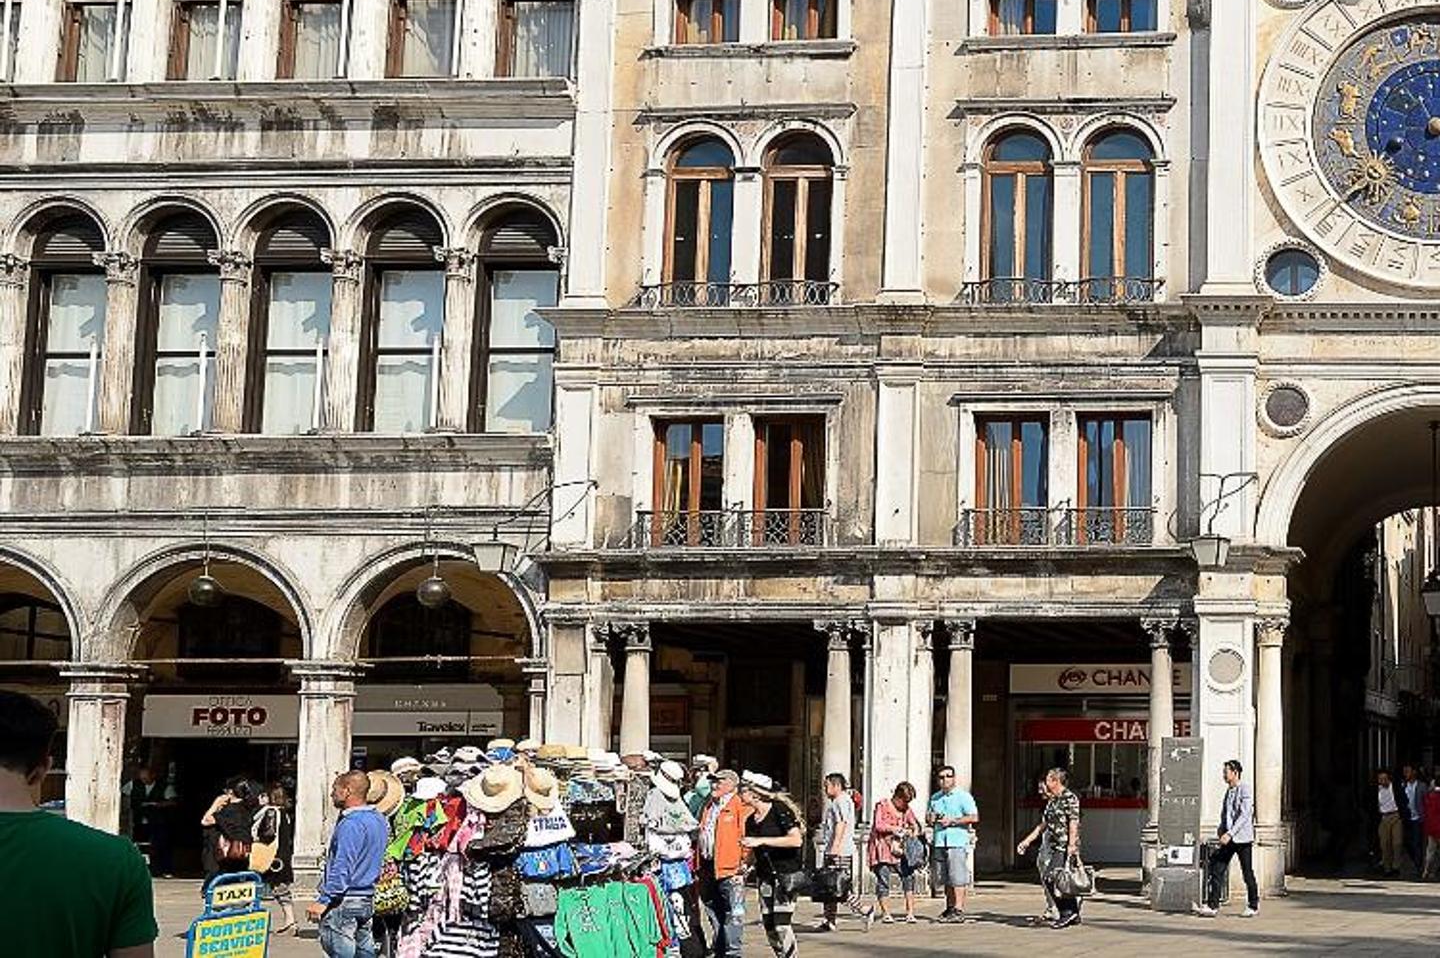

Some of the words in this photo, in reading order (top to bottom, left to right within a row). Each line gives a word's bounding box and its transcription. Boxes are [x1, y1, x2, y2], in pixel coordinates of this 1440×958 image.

[1091, 669, 1181, 686] CHANE
[192, 707, 267, 726] FOTO
[416, 721, 465, 732] Travelex
[1094, 721, 1192, 740] CHAE
[216, 888, 252, 901] TAXI
